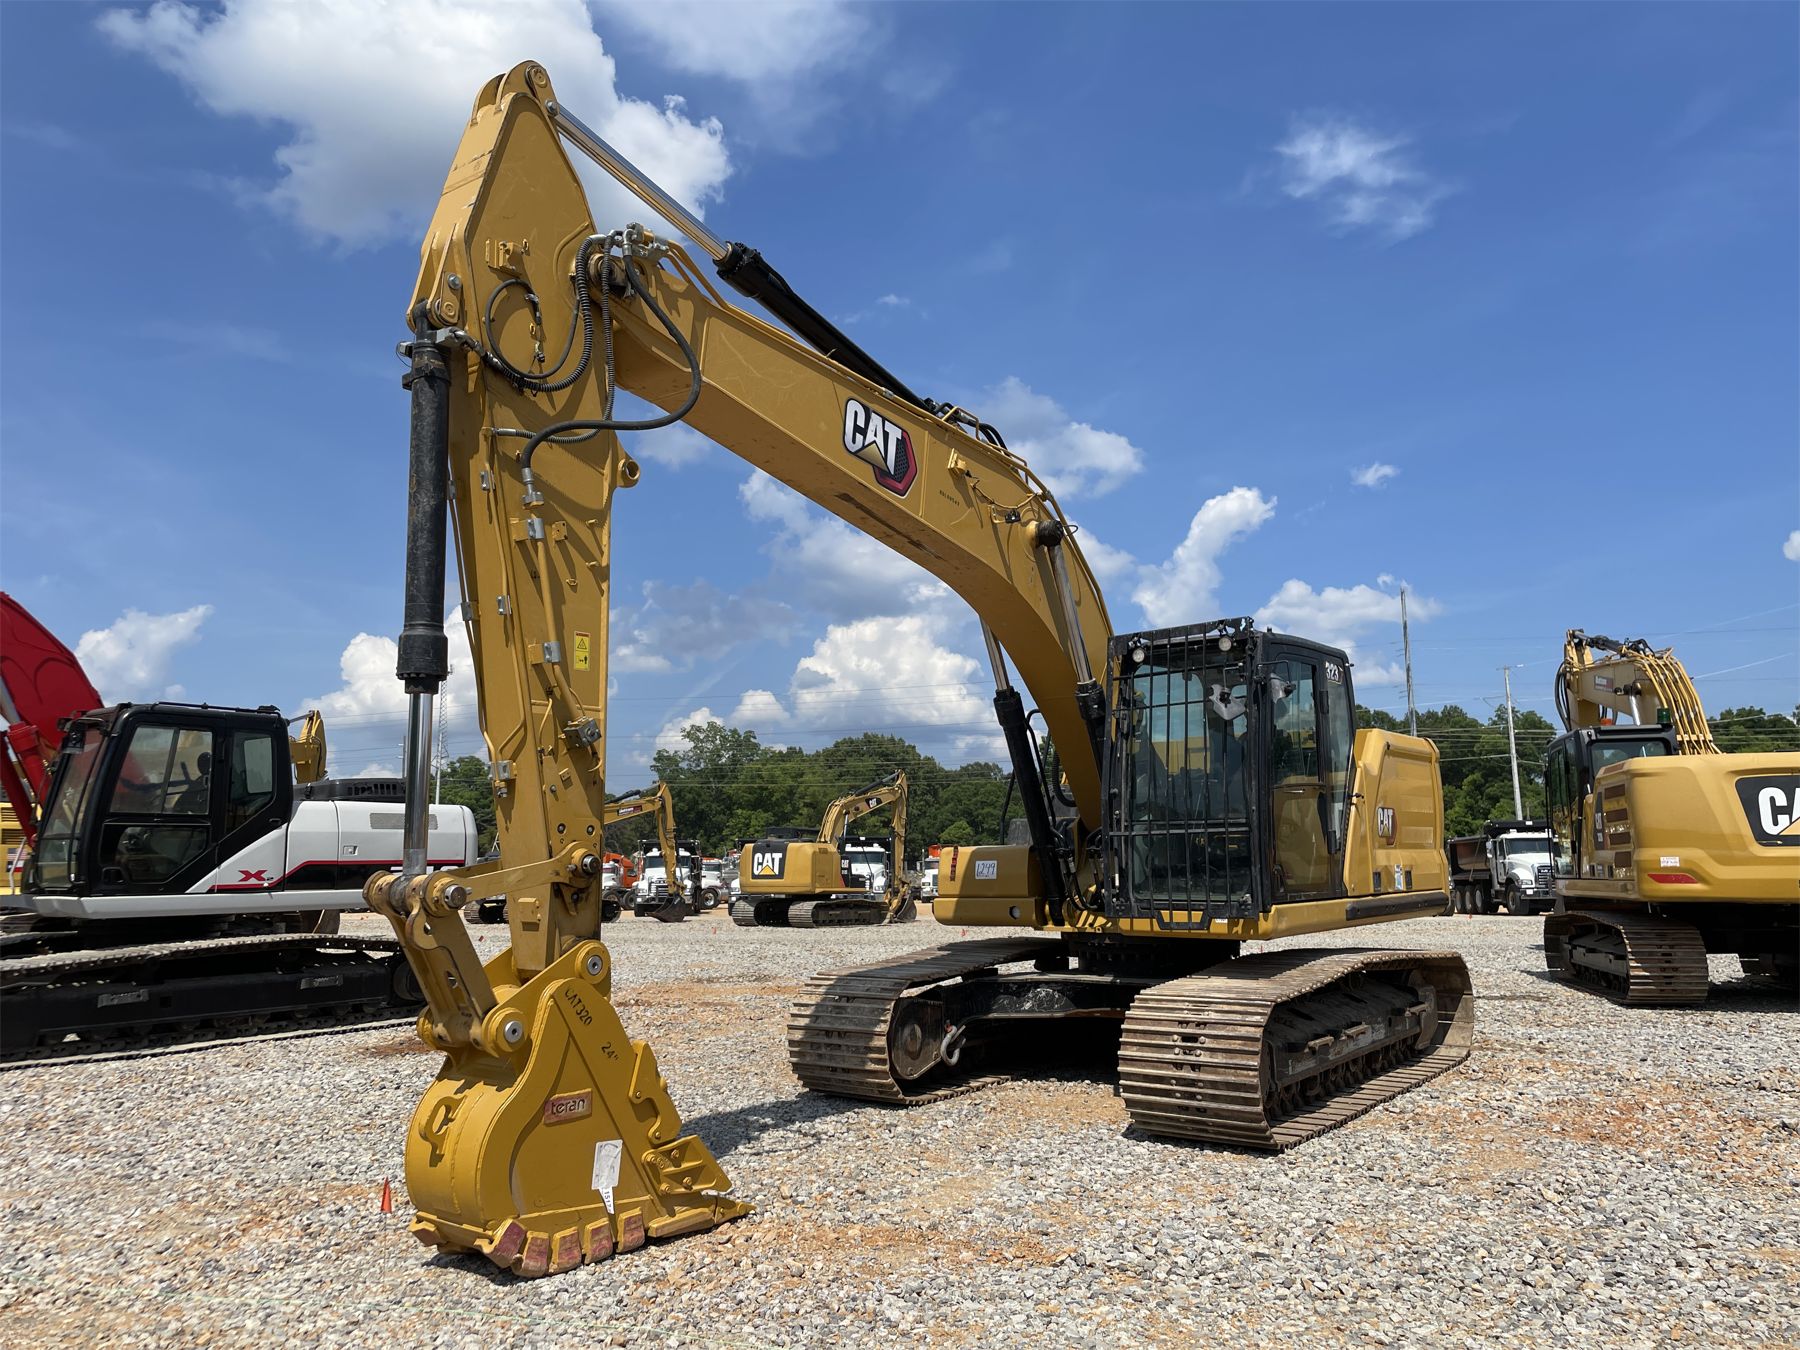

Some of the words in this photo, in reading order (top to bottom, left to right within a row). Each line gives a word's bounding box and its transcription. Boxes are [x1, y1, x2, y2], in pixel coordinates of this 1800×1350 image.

[845, 400, 902, 475] CAT
[1378, 808, 1393, 836] CAT
[753, 853, 783, 875] CAT
[564, 989, 592, 1026] CAT320
[551, 1098, 585, 1115] teran
